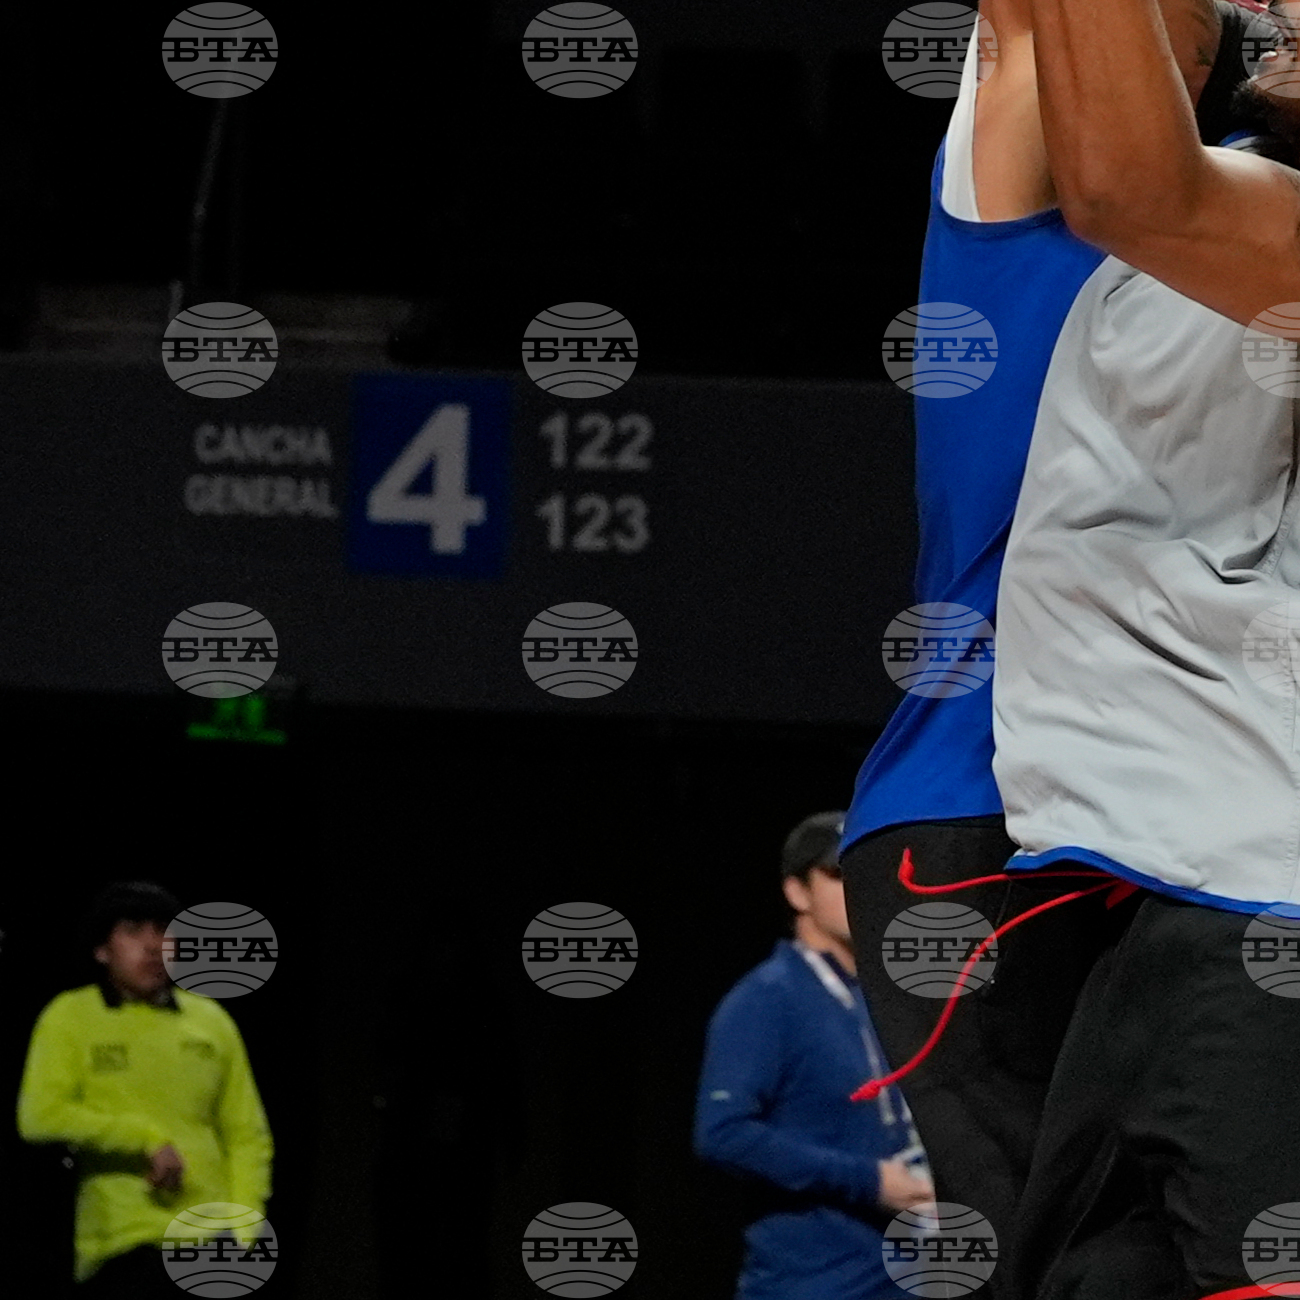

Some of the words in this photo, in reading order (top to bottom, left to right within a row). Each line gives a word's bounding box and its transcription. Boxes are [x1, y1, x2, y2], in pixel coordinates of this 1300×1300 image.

[193, 422, 332, 466] CANCHA
[538, 409, 655, 472] 122
[184, 472, 339, 519] GENERAL
[365, 401, 488, 556] 4
[534, 492, 651, 554] 123
